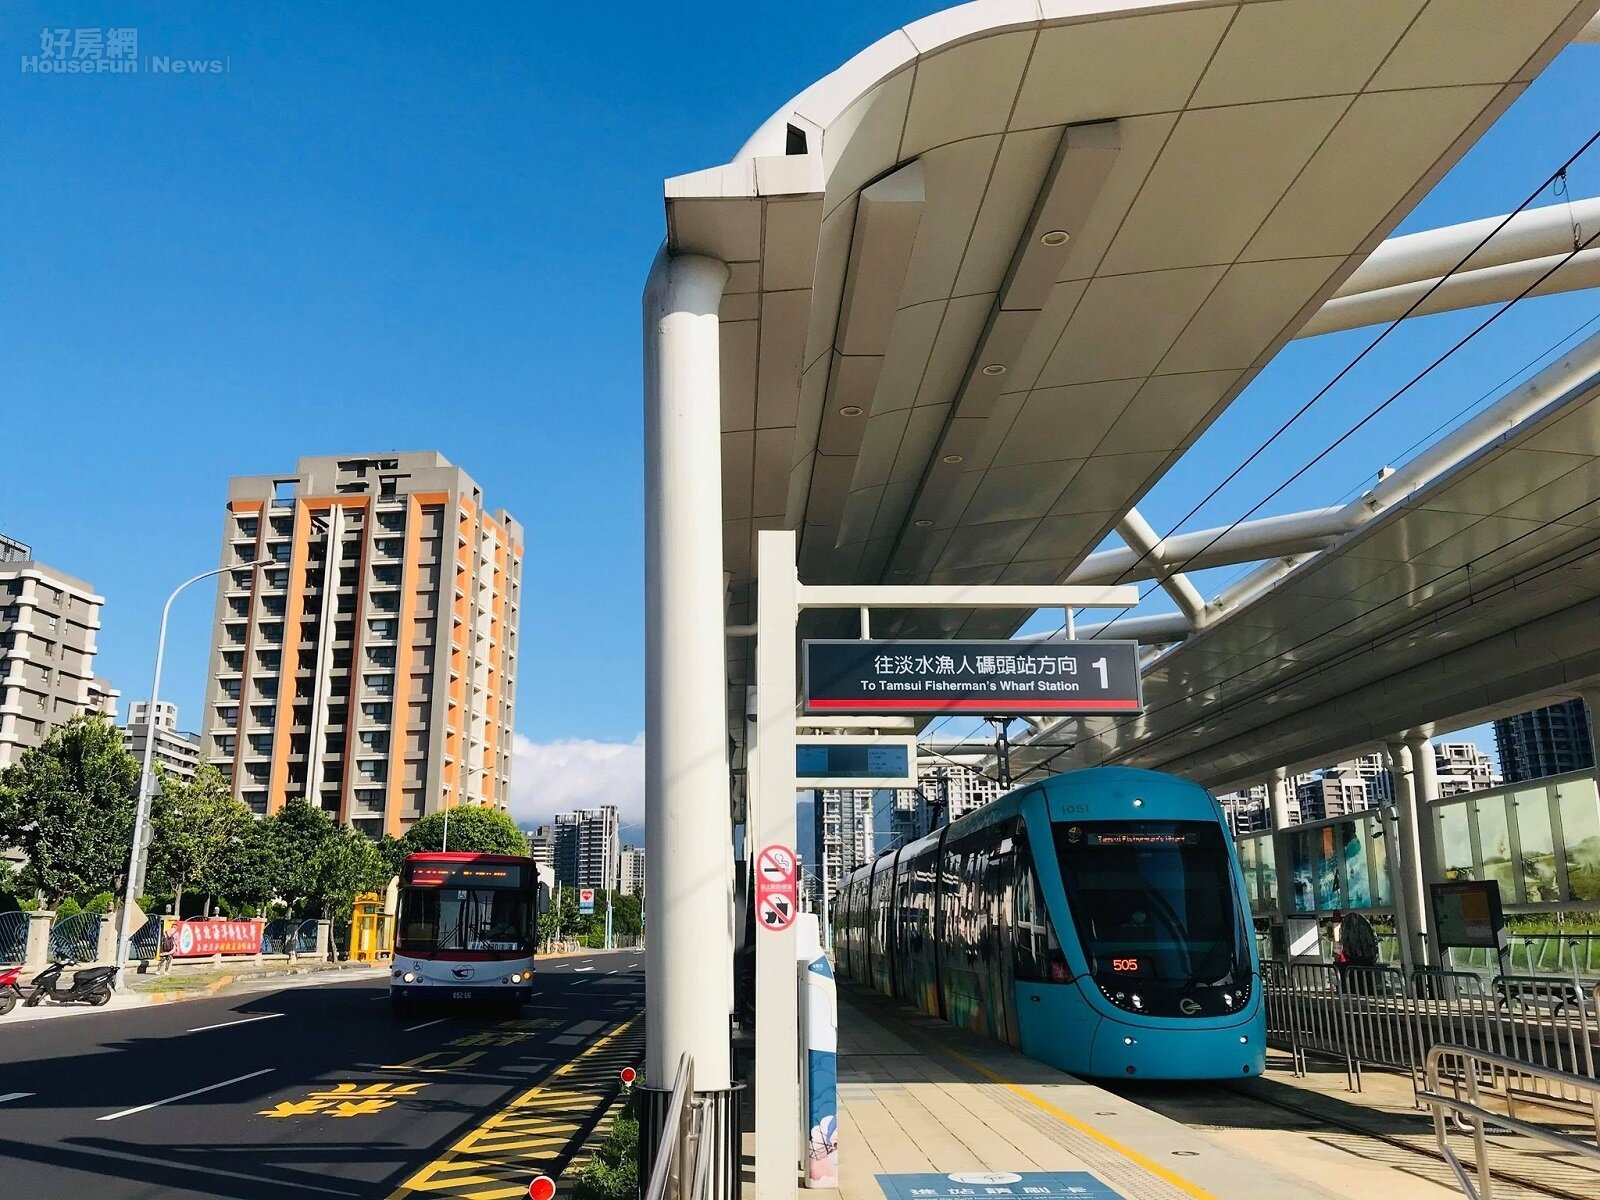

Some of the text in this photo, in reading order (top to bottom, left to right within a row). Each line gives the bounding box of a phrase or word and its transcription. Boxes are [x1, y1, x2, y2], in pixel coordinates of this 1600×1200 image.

[874, 655, 1077, 675] 往淡水漁人碼頭站方向
[1092, 657, 1109, 689] 1
[861, 680, 1080, 691] To Tamsui Fisherman's Wharf Station
[1112, 958, 1138, 971] 505
